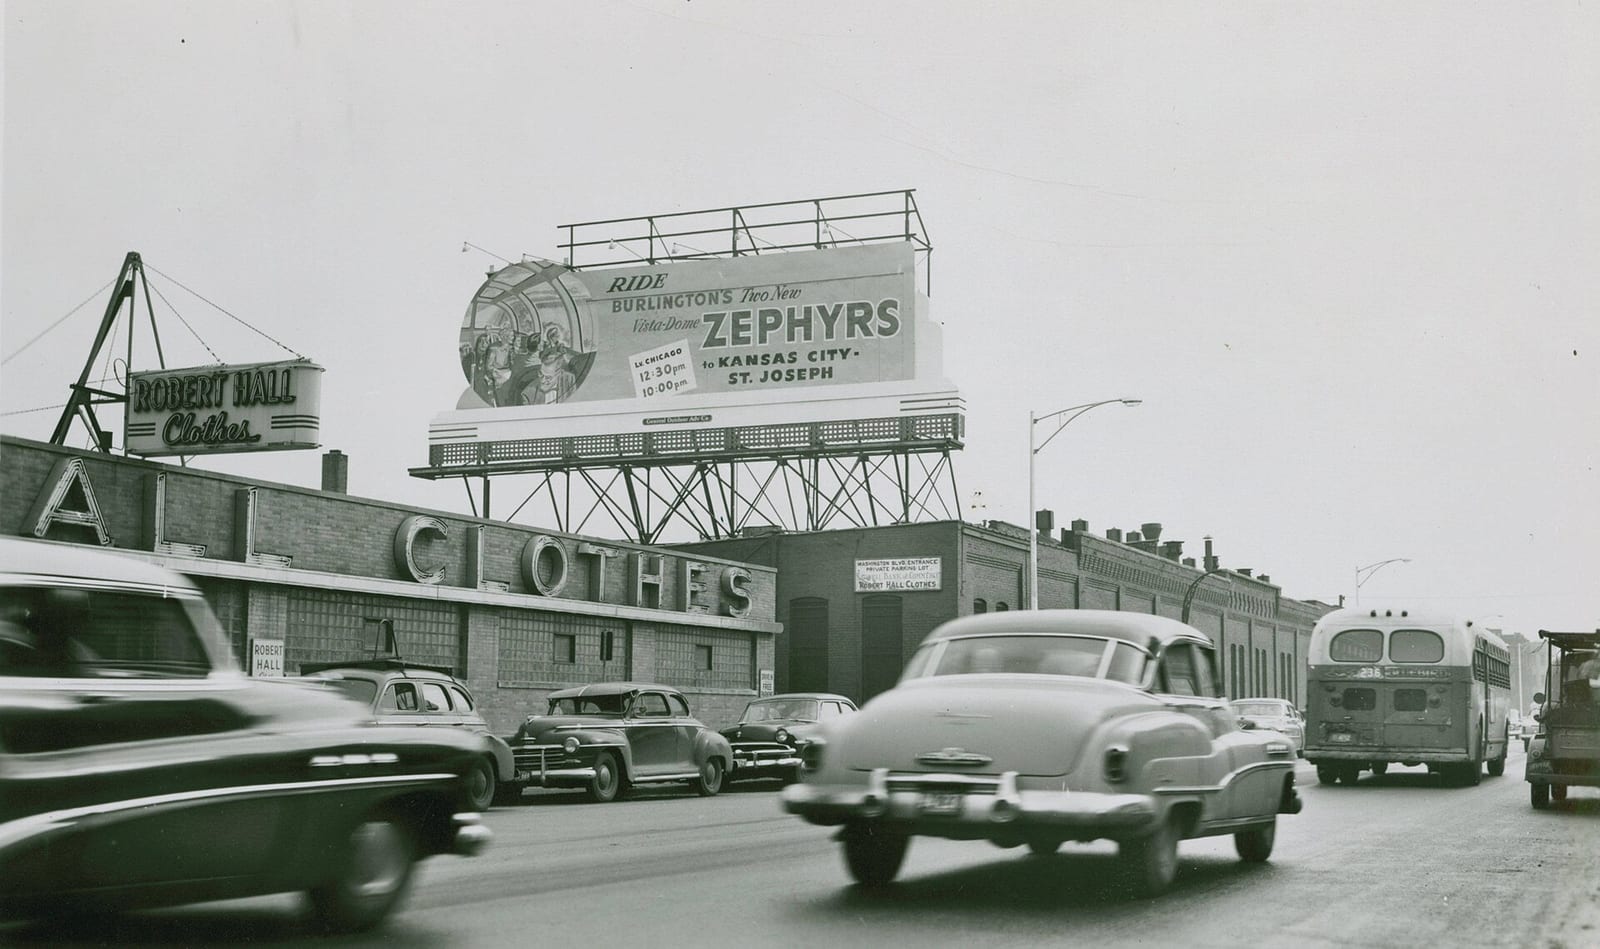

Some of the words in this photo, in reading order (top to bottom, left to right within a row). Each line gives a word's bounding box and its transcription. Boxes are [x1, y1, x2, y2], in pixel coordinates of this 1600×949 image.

[606, 273, 668, 294] RIDE
[612, 289, 733, 313] BURLINGTON'S
[739, 287, 770, 304] Two
[771, 284, 802, 301] New
[632, 316, 700, 333] Vista-Dome
[701, 298, 901, 350] ZEPHYRS
[645, 348, 682, 365] CHICAGO
[702, 360, 715, 369] to
[718, 351, 798, 368] KANSAS
[728, 372, 753, 385] ST.
[759, 366, 833, 383] JOSEPH
[133, 373, 229, 413] ROBERT
[232, 368, 297, 408] HALL
[161, 410, 262, 446] Clothes
[395, 515, 753, 618] CLOTHES
[905, 580, 937, 588] CLOTHES
[254, 645, 283, 656] ROBERT
[257, 659, 281, 670] HALL
